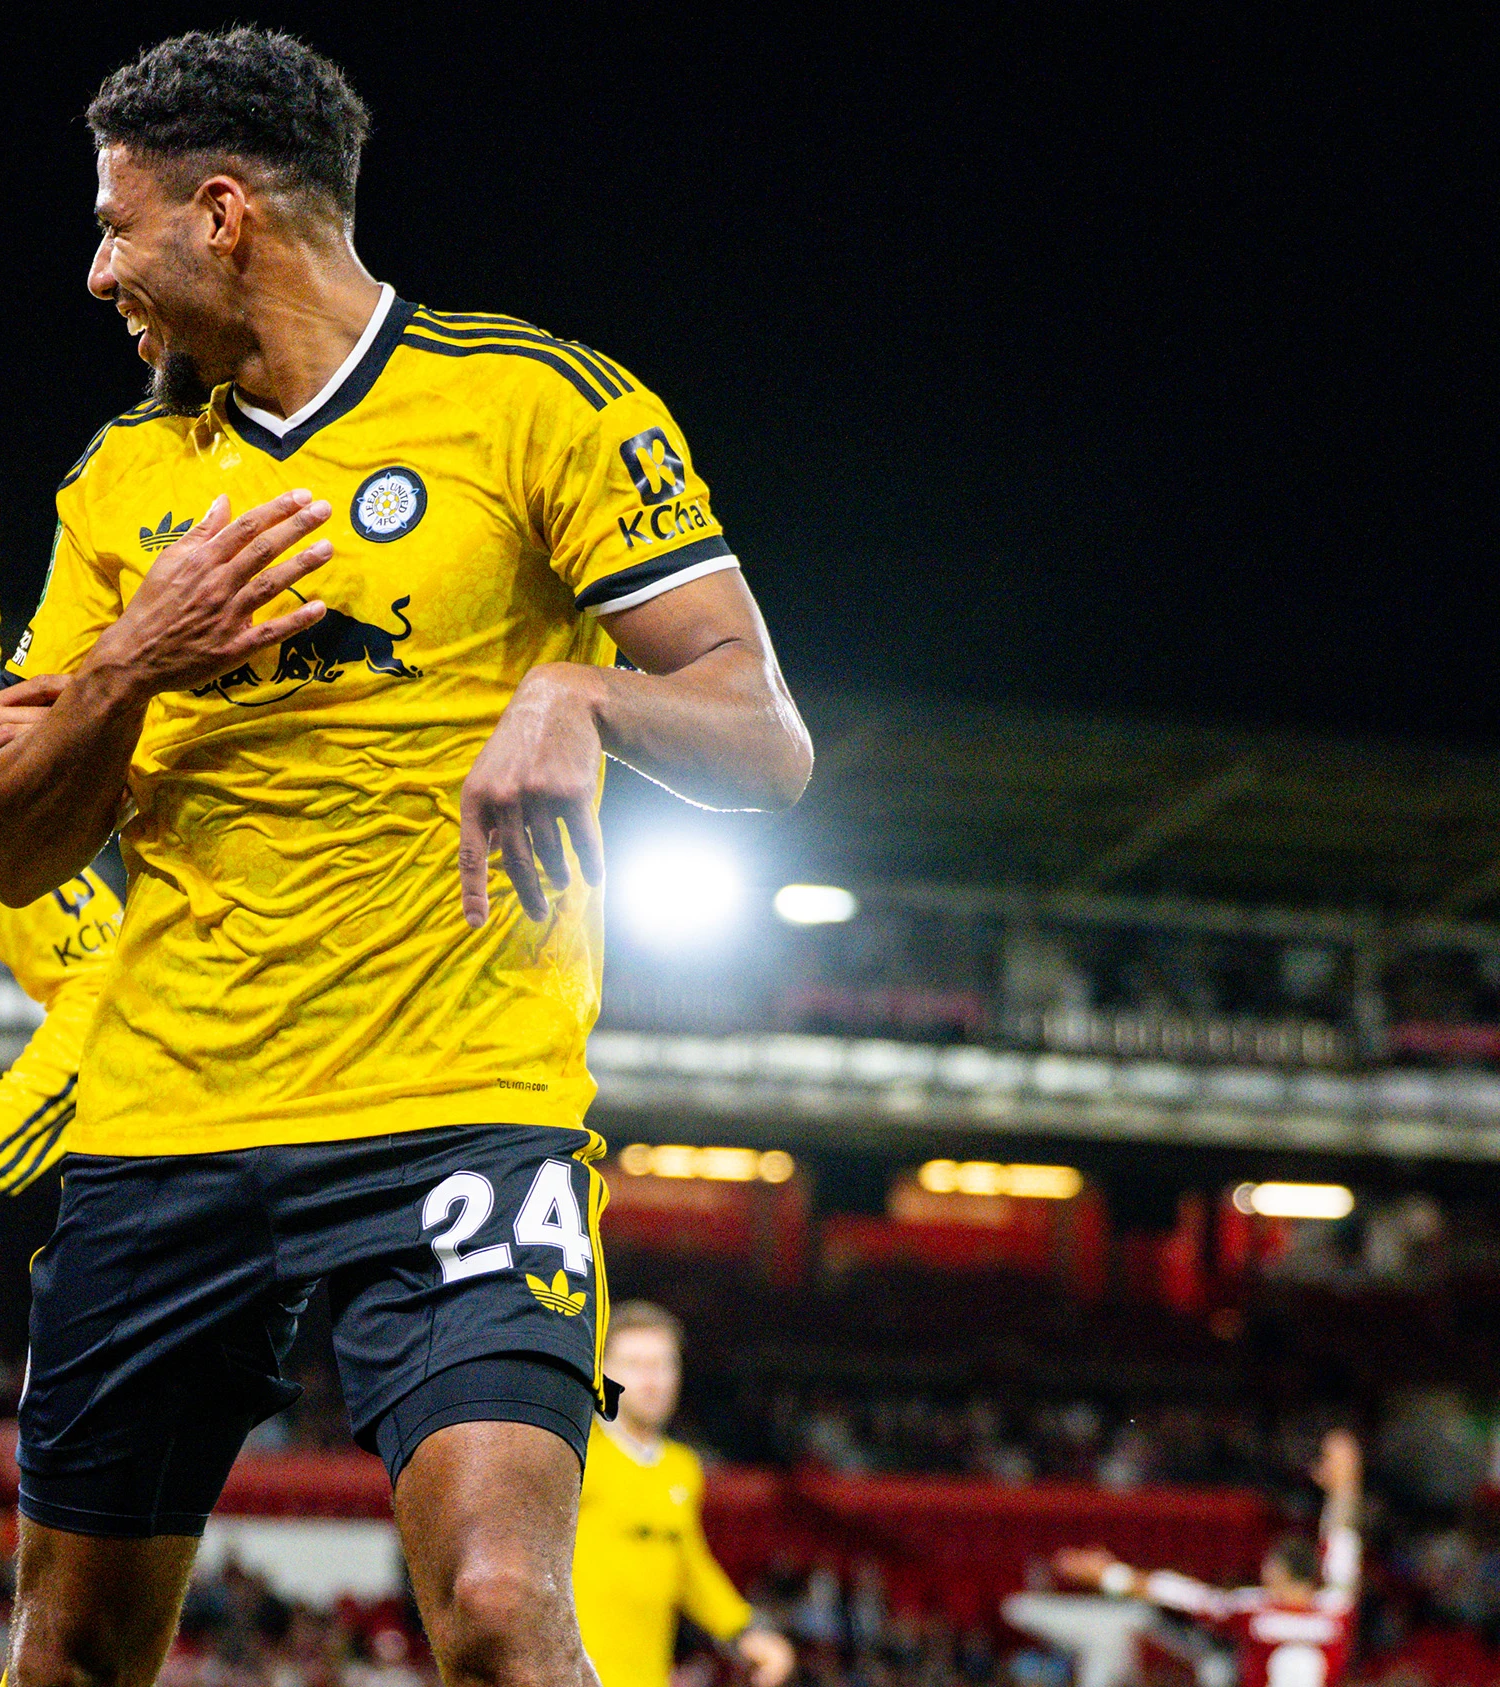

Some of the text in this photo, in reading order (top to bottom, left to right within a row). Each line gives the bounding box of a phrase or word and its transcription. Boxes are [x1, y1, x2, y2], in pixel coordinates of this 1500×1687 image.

[366, 483, 409, 517] LEEDS UNITED
[376, 515, 396, 526] AFC
[618, 501, 712, 547] KCha
[53, 914, 121, 967] KCh
[422, 1158, 593, 1284] 24
